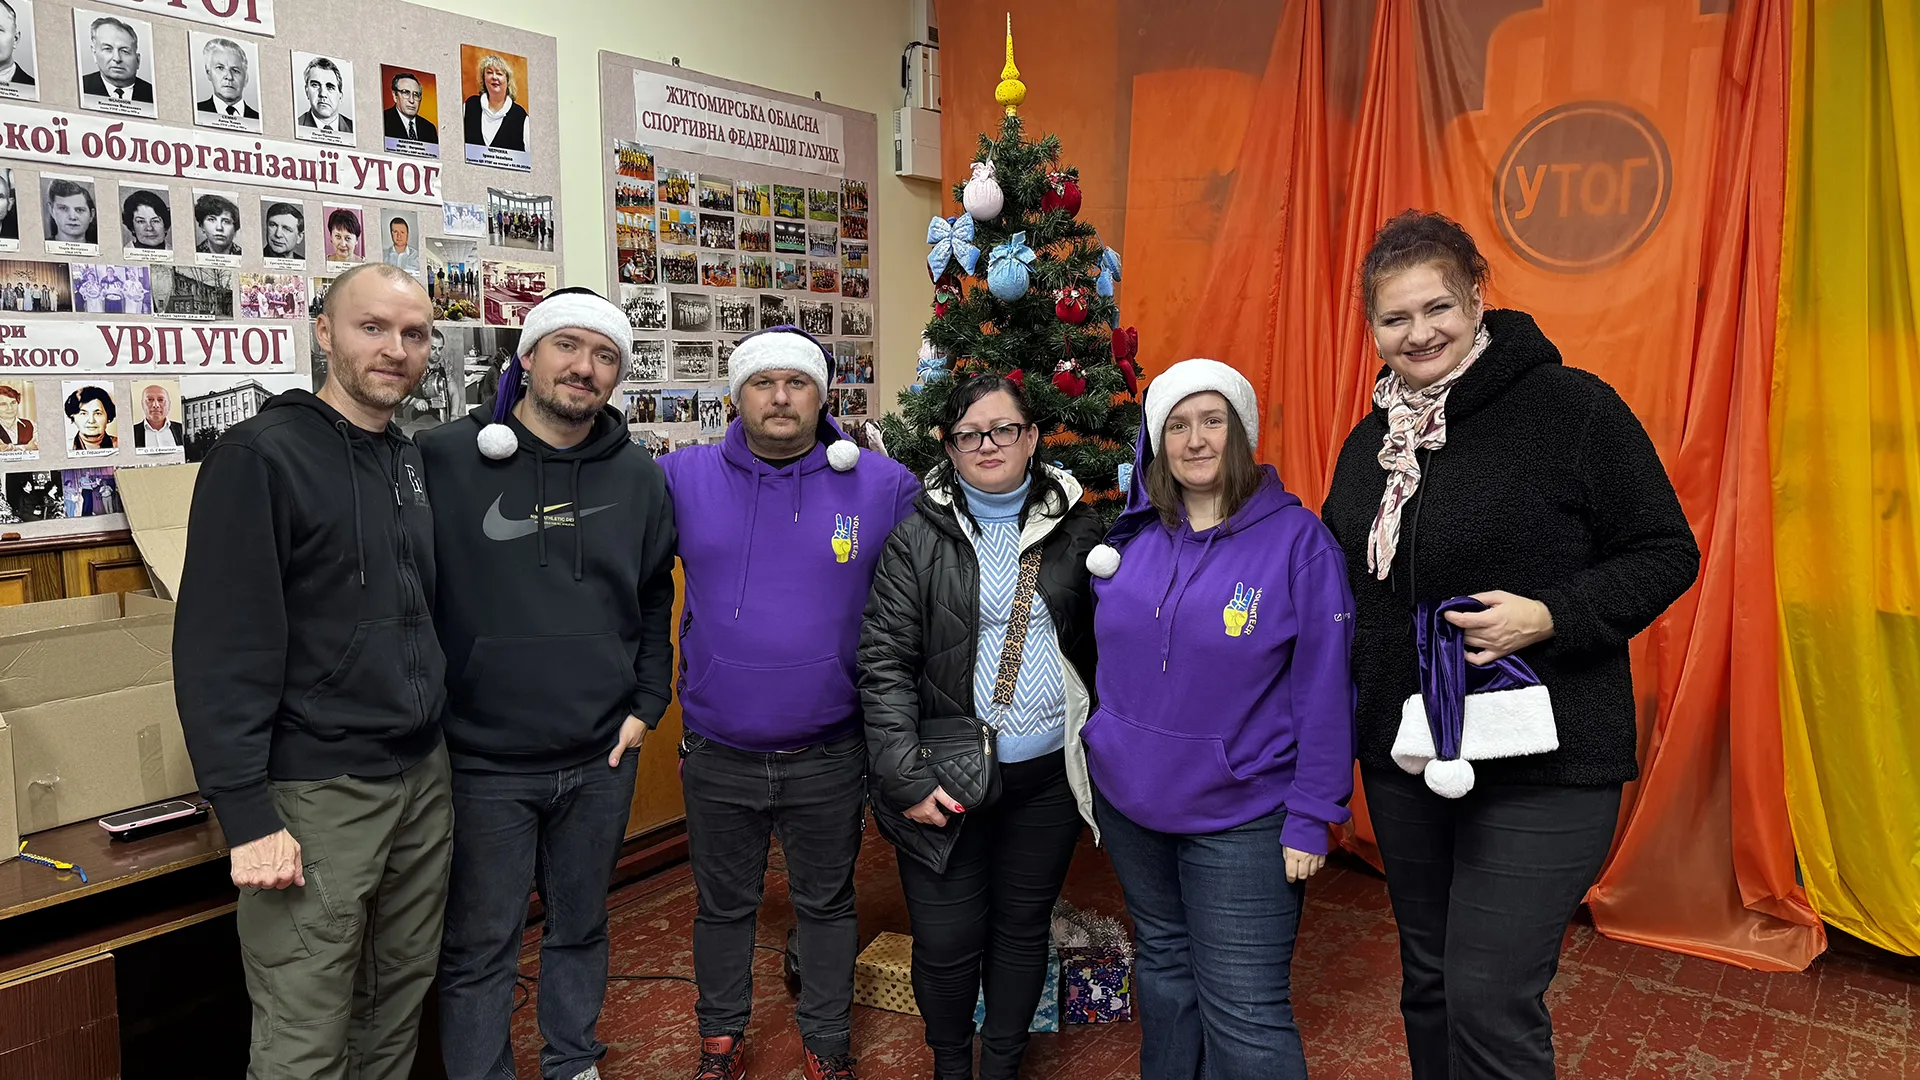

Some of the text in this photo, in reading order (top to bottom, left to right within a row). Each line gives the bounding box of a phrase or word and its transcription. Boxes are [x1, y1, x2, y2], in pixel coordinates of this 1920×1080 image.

[665, 85, 820, 134] ЖИТОМИРСЬКА ОБЛАСНА
[0, 117, 71, 155] кої
[81, 122, 340, 190] облорганізації
[348, 155, 440, 197] УТОГ
[642, 111, 840, 164] СПОРТИВНА ФЕДЕРАЦІЯ ГЛУХИХ
[1514, 157, 1650, 220] УТОГ
[97, 325, 288, 367] УВП УТОГ
[850, 515, 860, 560] VOLUNTEER
[1244, 587, 1262, 635] VOLUNTEER
